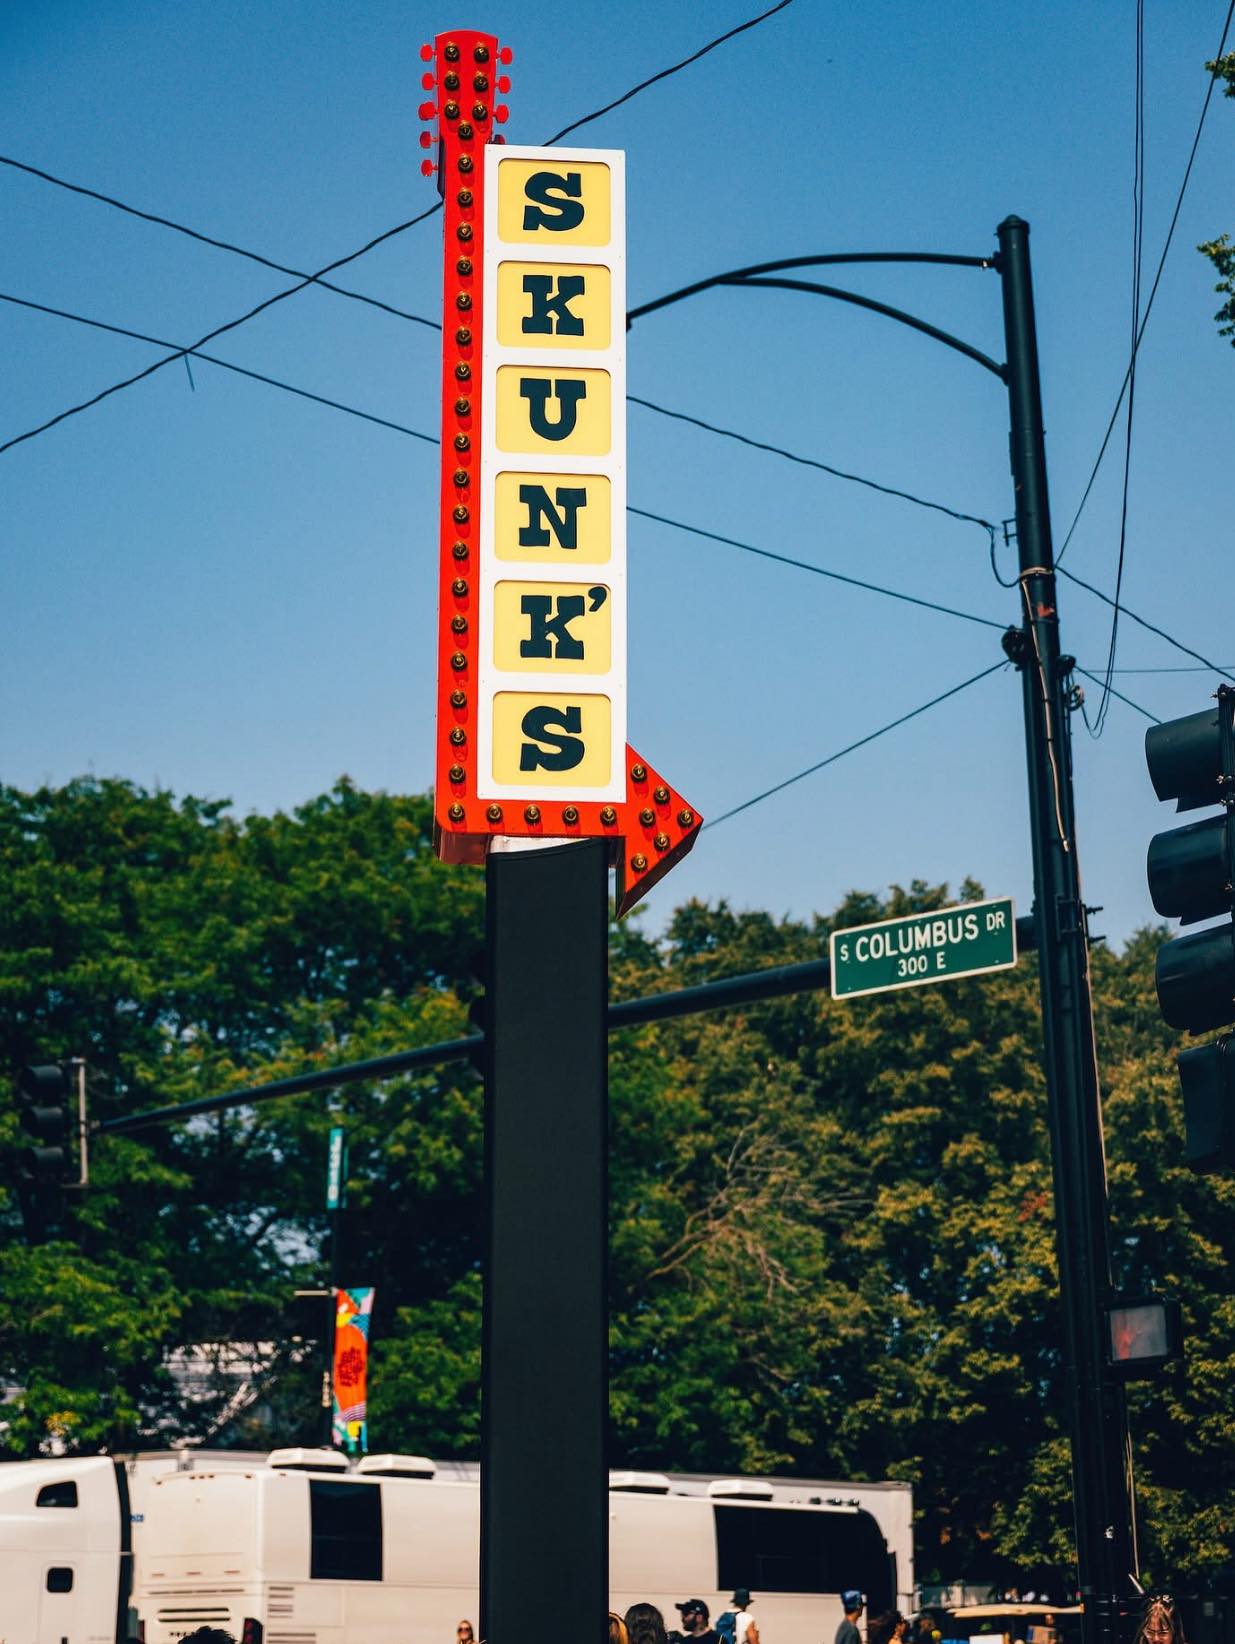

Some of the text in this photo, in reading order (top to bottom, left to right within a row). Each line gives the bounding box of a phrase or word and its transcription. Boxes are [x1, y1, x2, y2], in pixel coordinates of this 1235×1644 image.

[840, 911, 1005, 962] S COLUMBUS DR
[898, 951, 946, 977] 300 E
